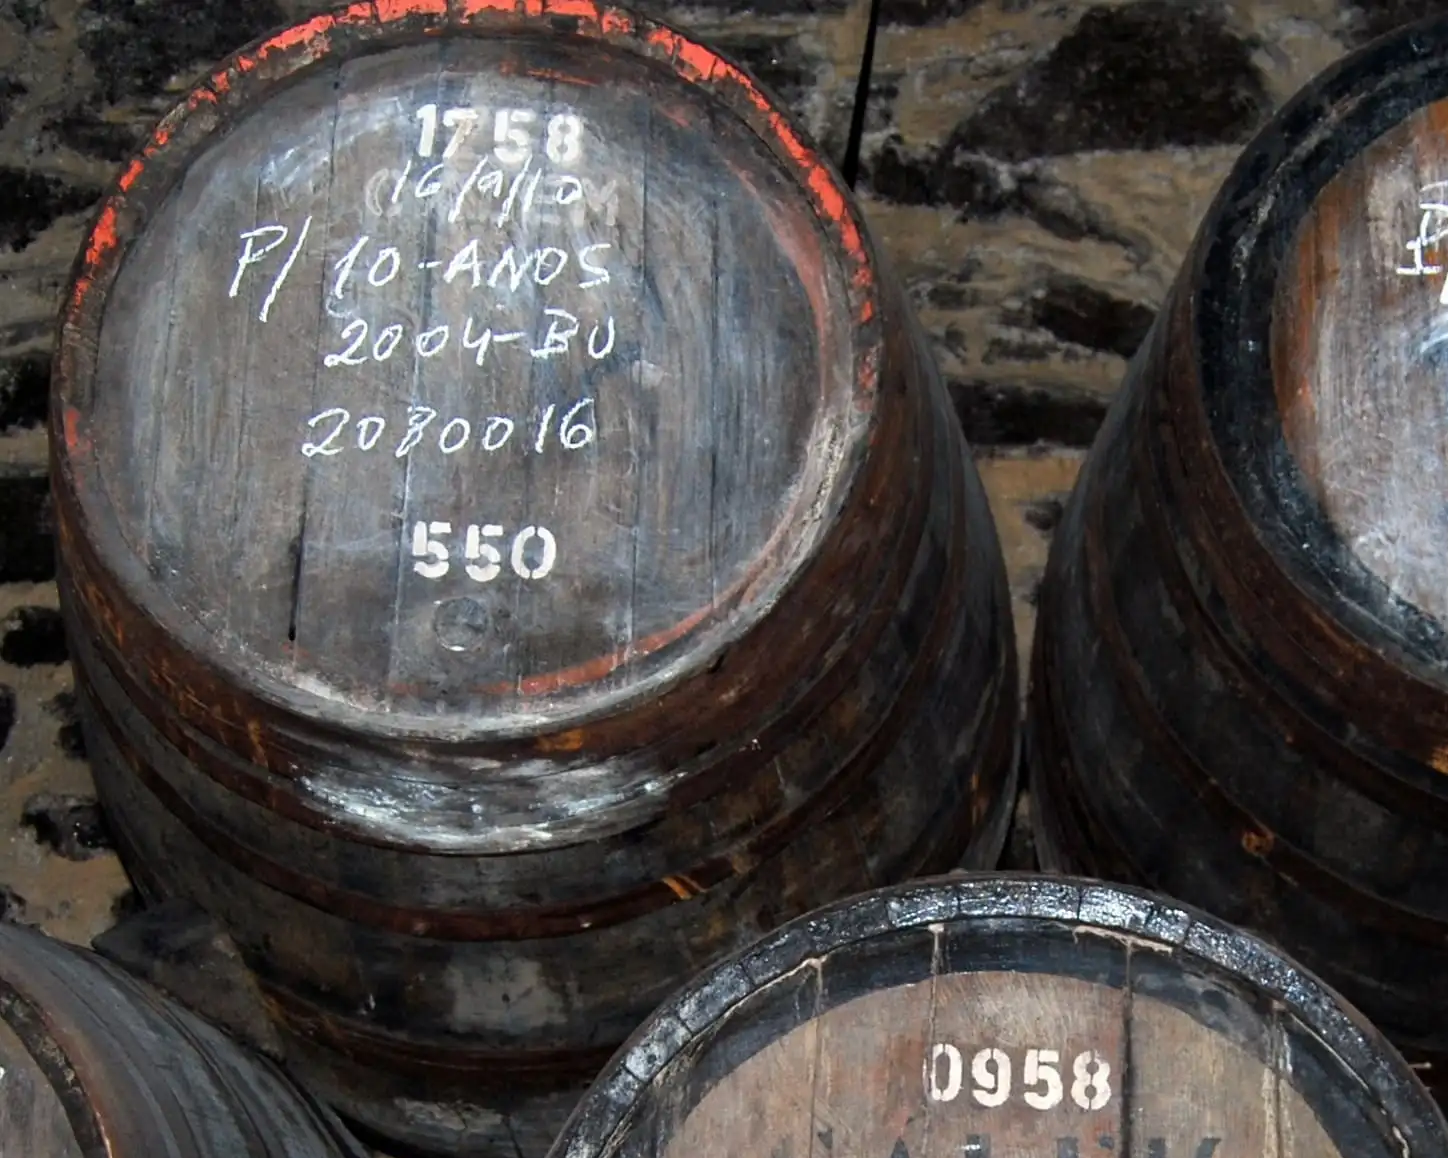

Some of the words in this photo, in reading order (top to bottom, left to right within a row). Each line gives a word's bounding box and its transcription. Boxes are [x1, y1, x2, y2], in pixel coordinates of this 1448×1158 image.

[415, 103, 586, 164] 1758
[412, 520, 558, 583] 550
[925, 1043, 1113, 1112] 0958
